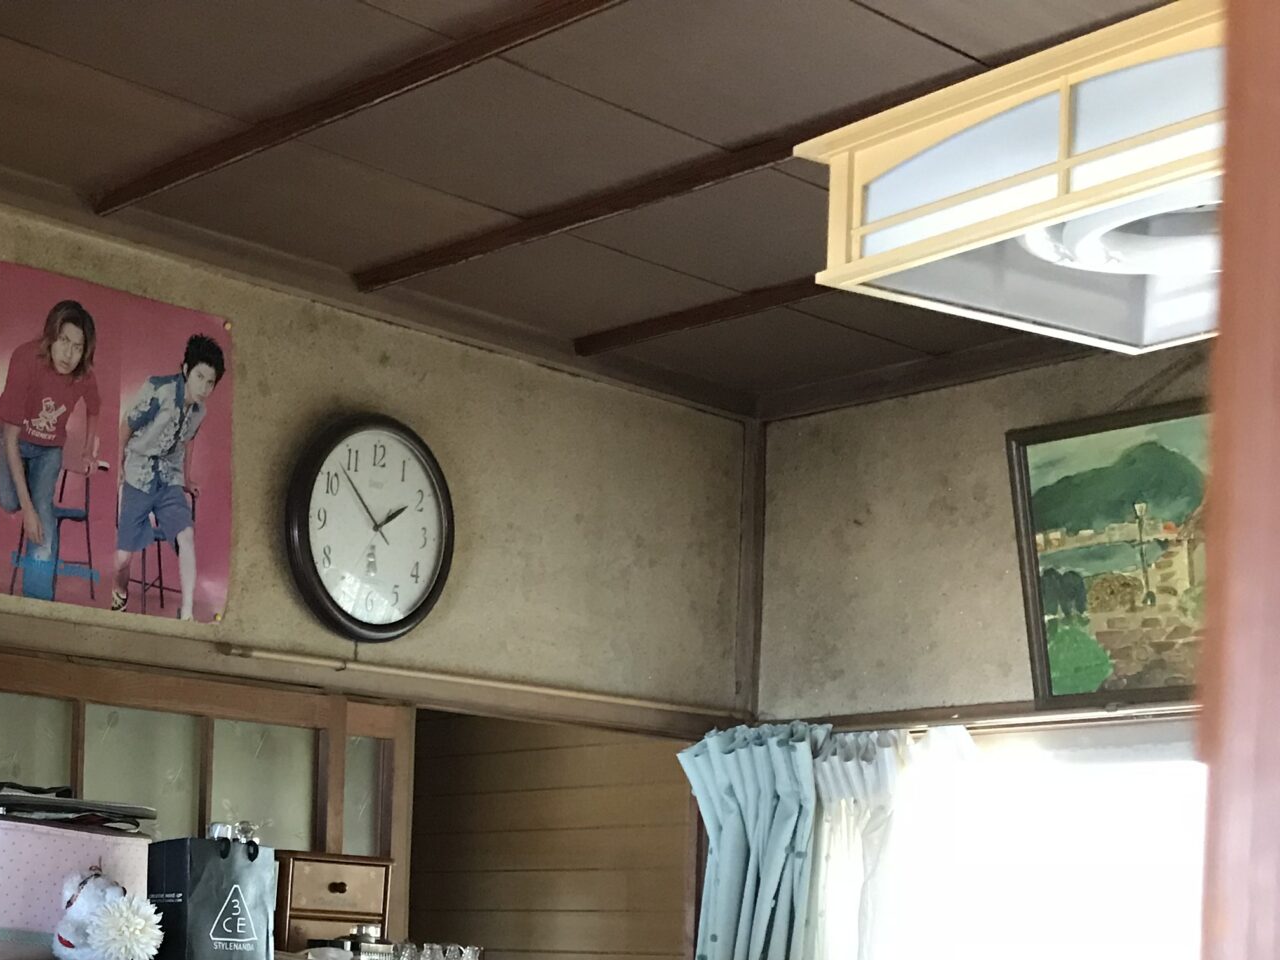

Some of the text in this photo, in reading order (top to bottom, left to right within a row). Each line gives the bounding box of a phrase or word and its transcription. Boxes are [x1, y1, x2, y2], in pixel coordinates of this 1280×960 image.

[346, 448, 359, 473] 11
[371, 444, 387, 468] 12
[400, 460, 405, 483] 1
[325, 471, 340, 496] 10
[414, 489, 424, 512] 2
[317, 507, 327, 530] 9
[419, 526, 427, 549] 3
[322, 545, 331, 568] 8
[410, 561, 420, 584] 4
[365, 591, 373, 611] 6
[392, 584, 400, 606] 5
[231, 899, 241, 916] 3
[213, 941, 254, 952] STYLENANDA
